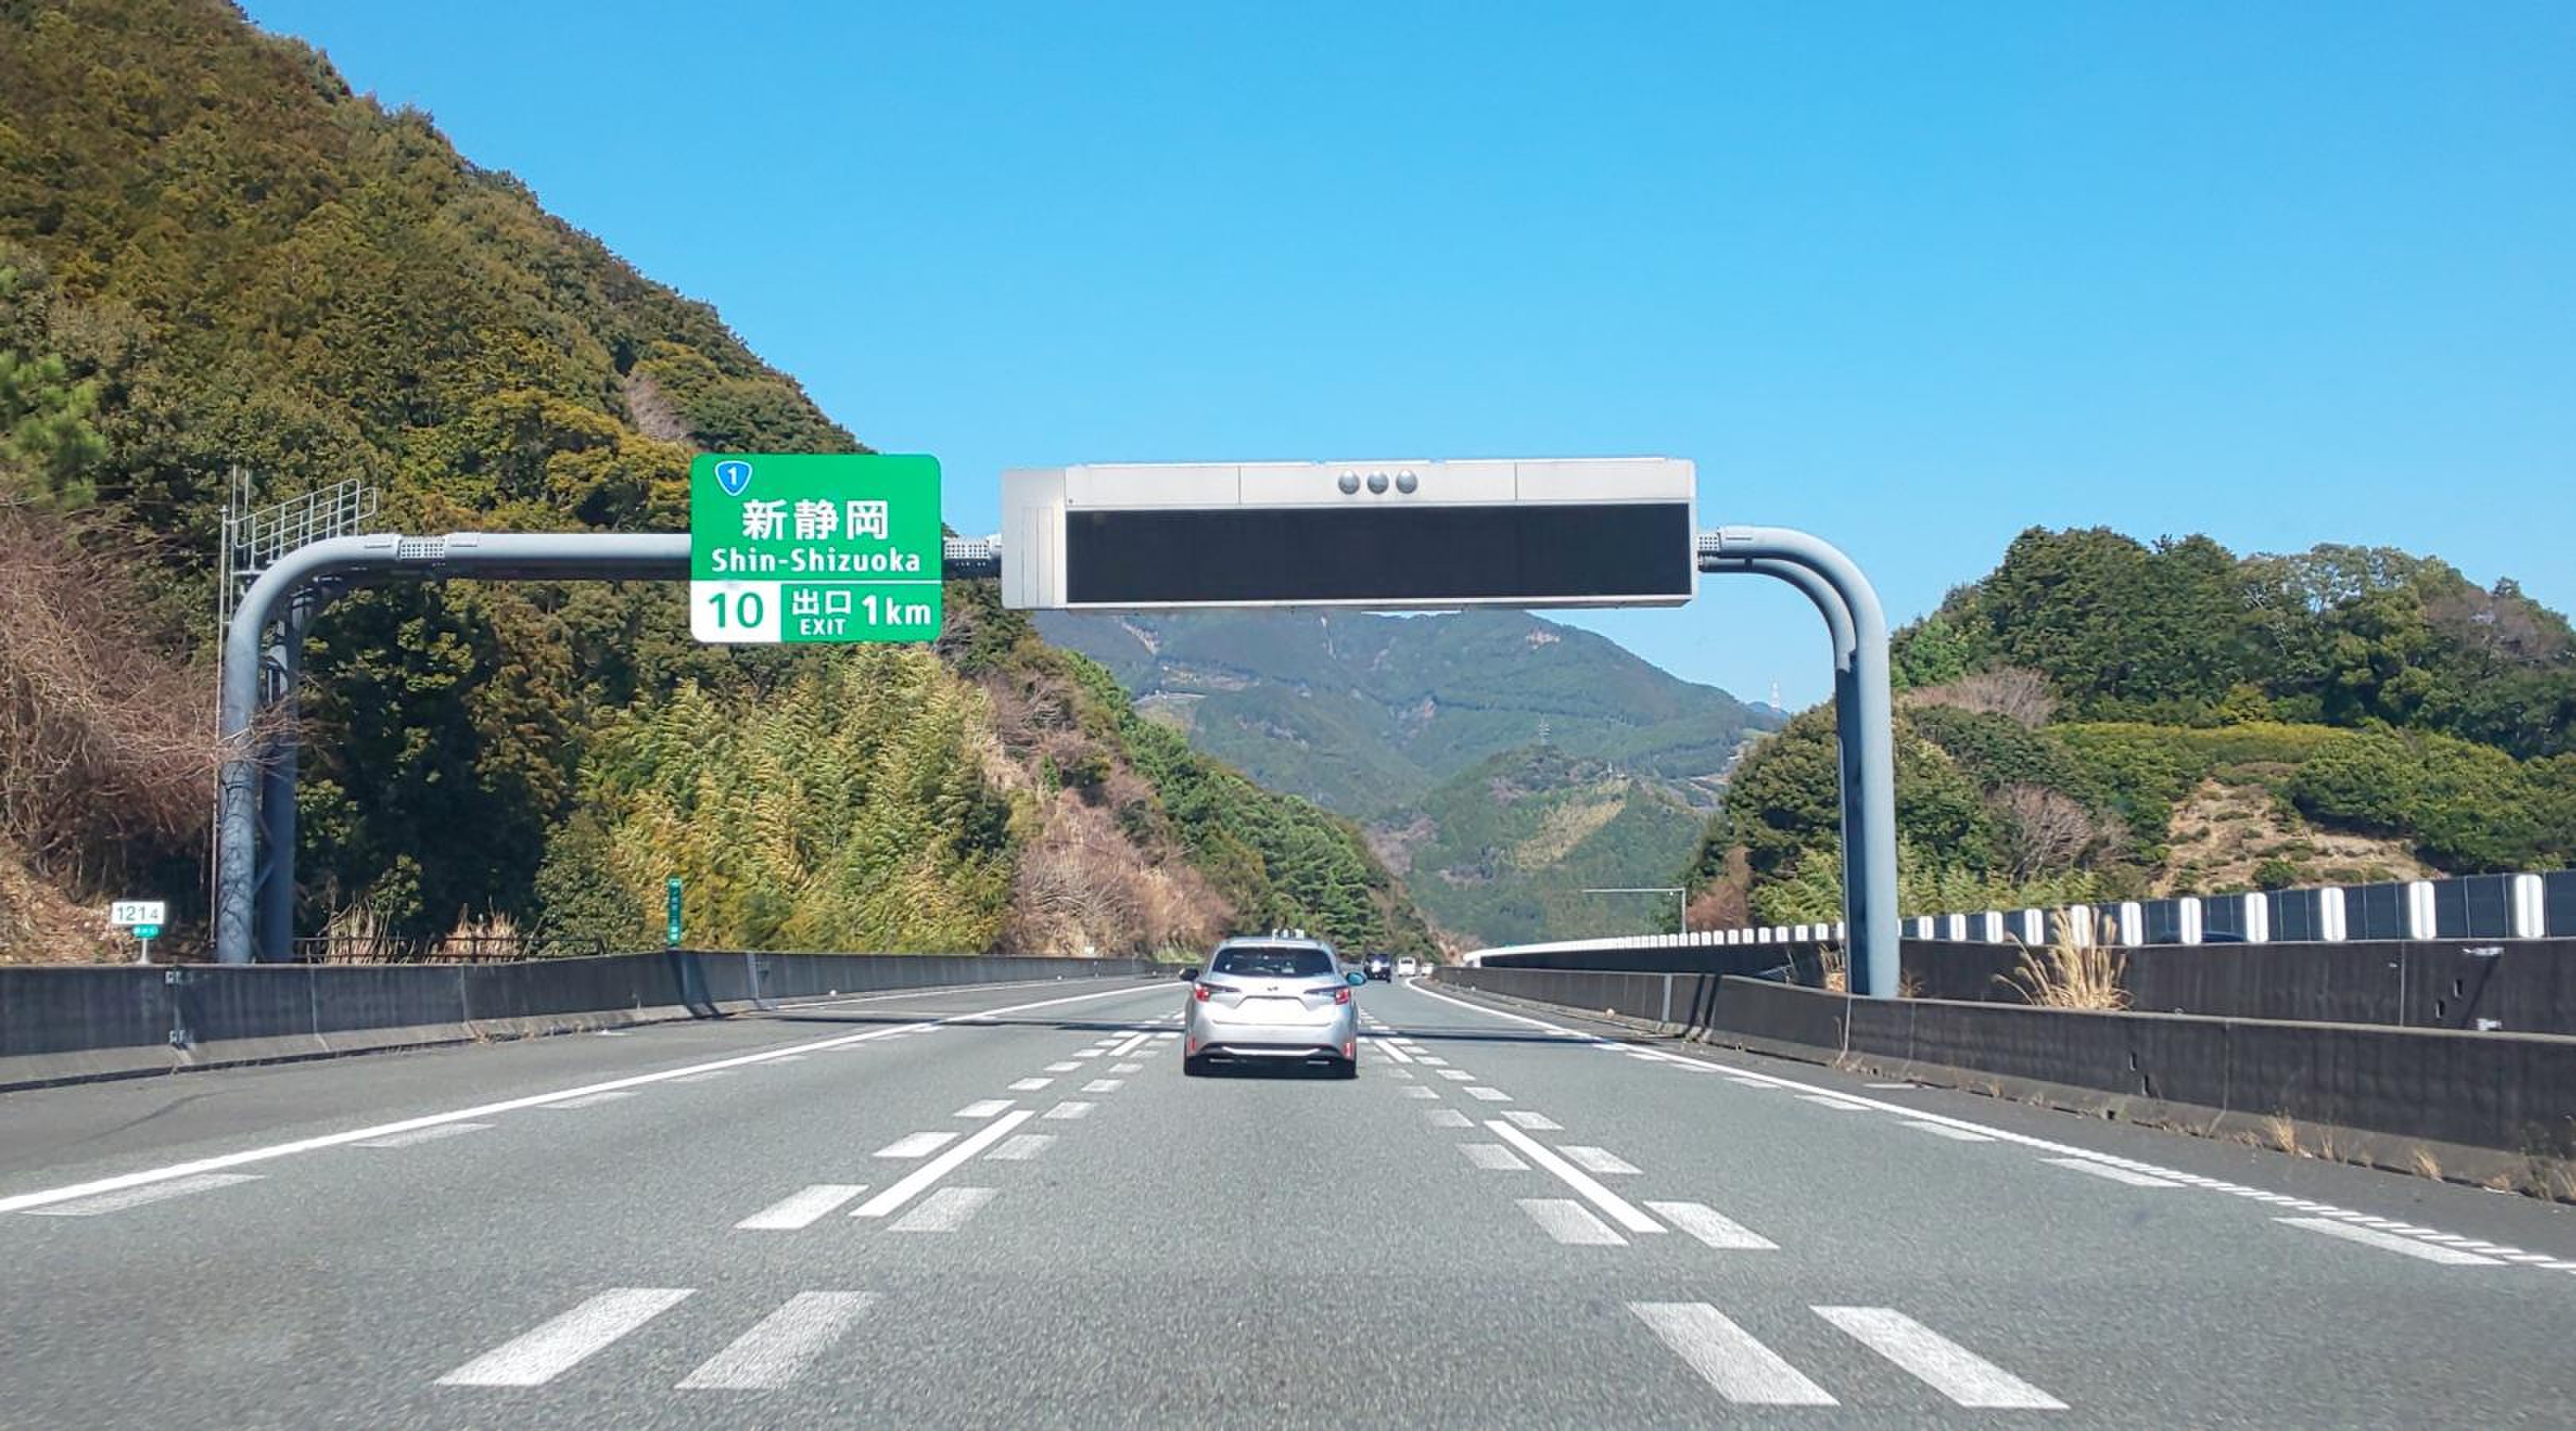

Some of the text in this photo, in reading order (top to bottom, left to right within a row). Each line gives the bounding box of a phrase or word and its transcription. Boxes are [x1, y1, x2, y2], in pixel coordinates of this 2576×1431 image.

[727, 467, 737, 486] 1
[743, 498, 888, 541] 新静岡
[712, 547, 920, 572] Shin-Shizuoka
[708, 591, 764, 629] 10
[792, 589, 851, 615] 出口
[800, 619, 847, 636] EXIT
